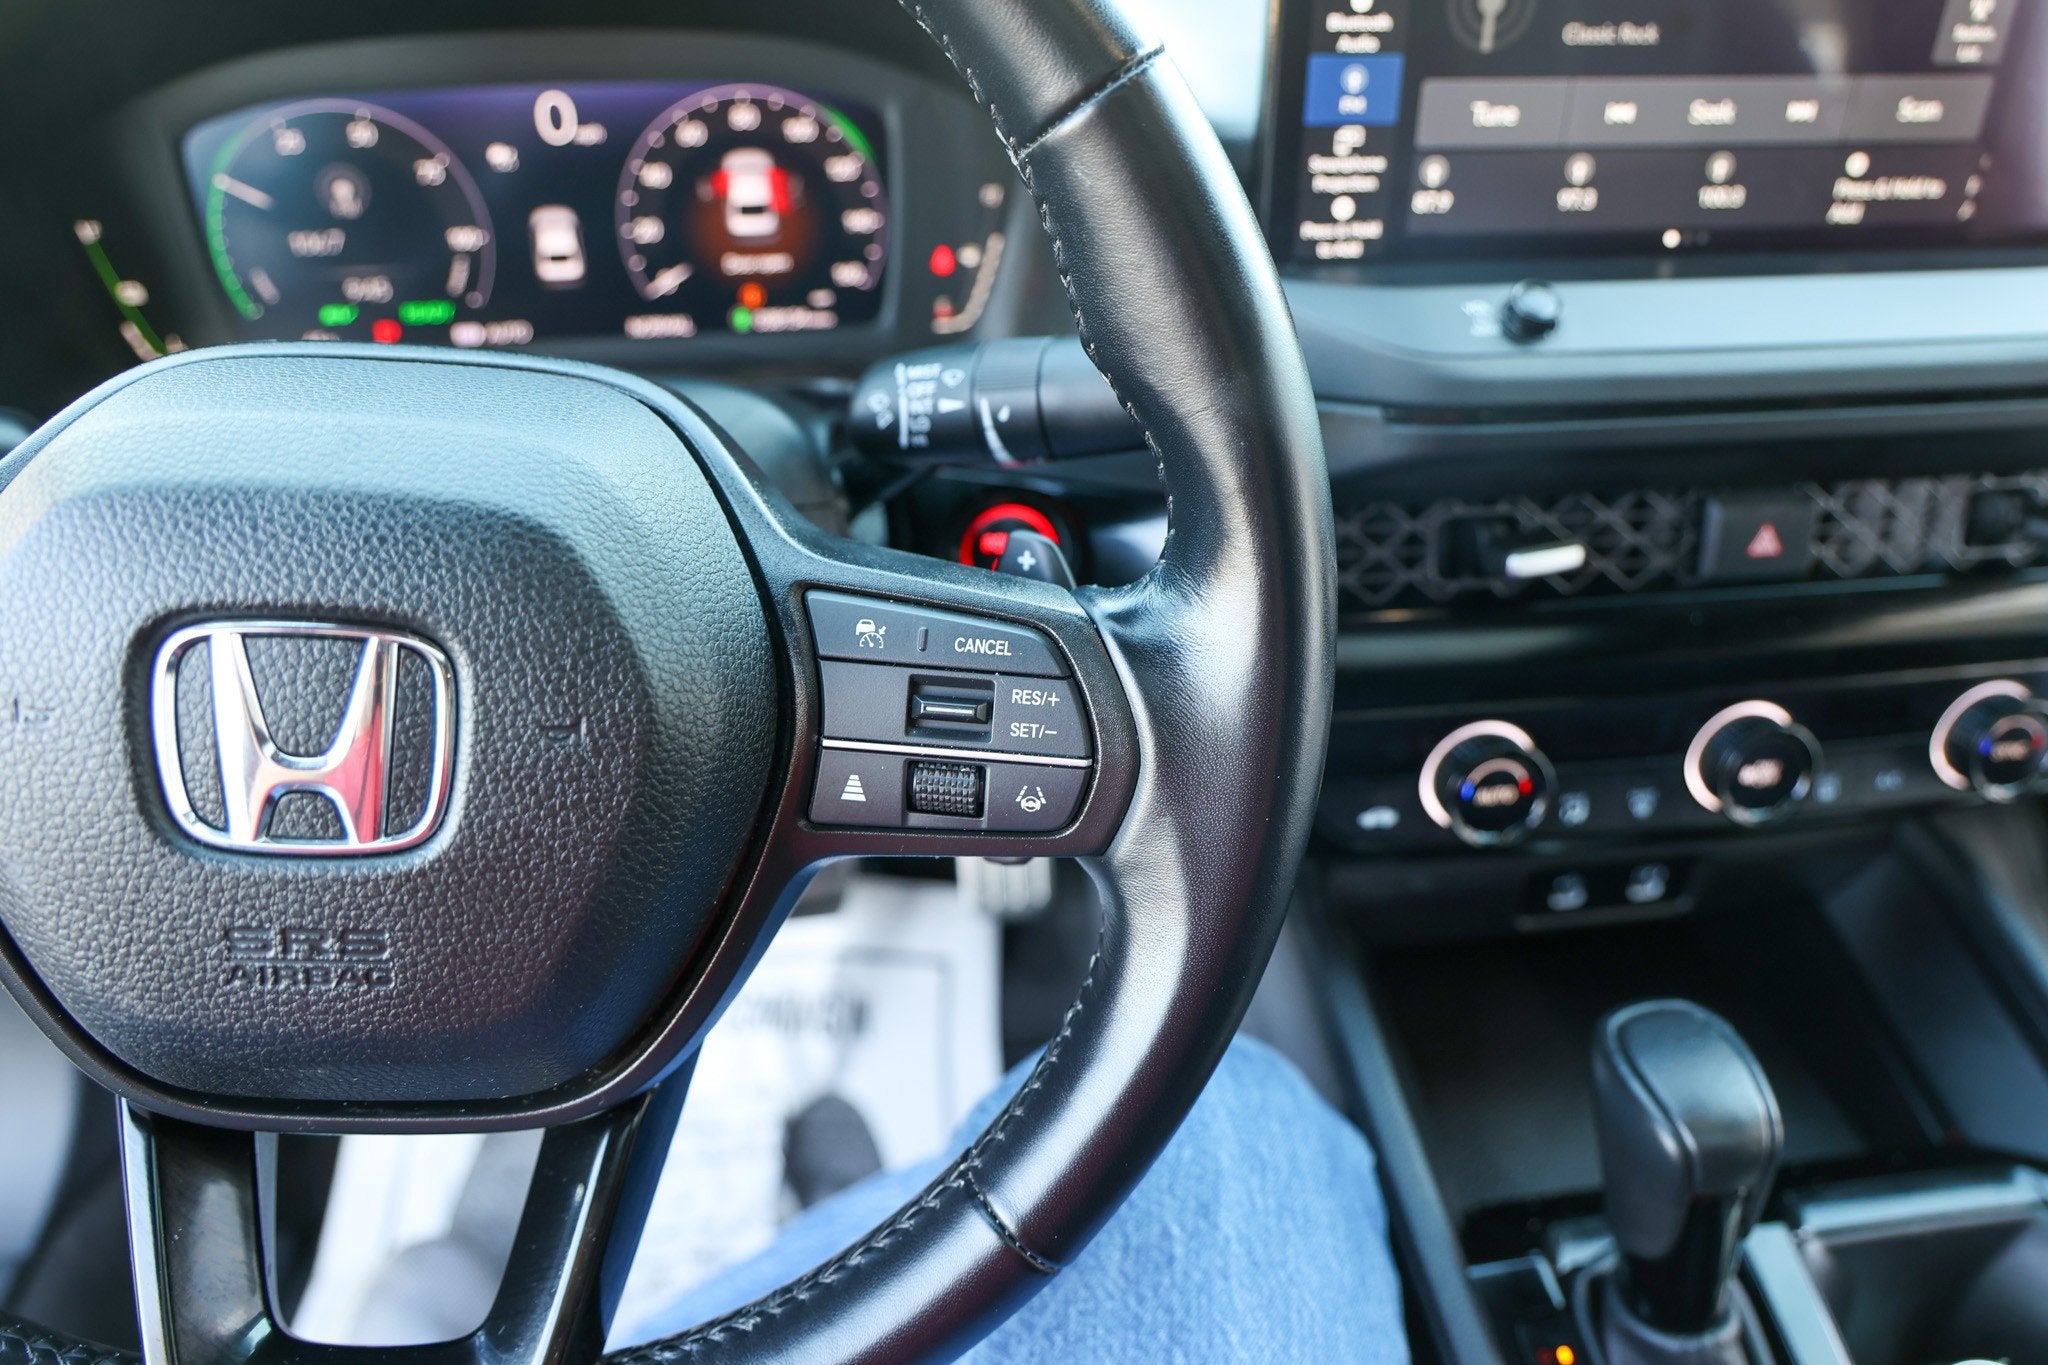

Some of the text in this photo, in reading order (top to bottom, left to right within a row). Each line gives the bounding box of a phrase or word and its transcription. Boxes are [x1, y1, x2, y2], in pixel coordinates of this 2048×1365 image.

[533, 89, 579, 146] 0
[954, 636, 1012, 656] CANCEL
[1011, 689, 1060, 706] RES/+
[224, 928, 390, 960] SRS
[222, 963, 395, 989] AIRBAG
